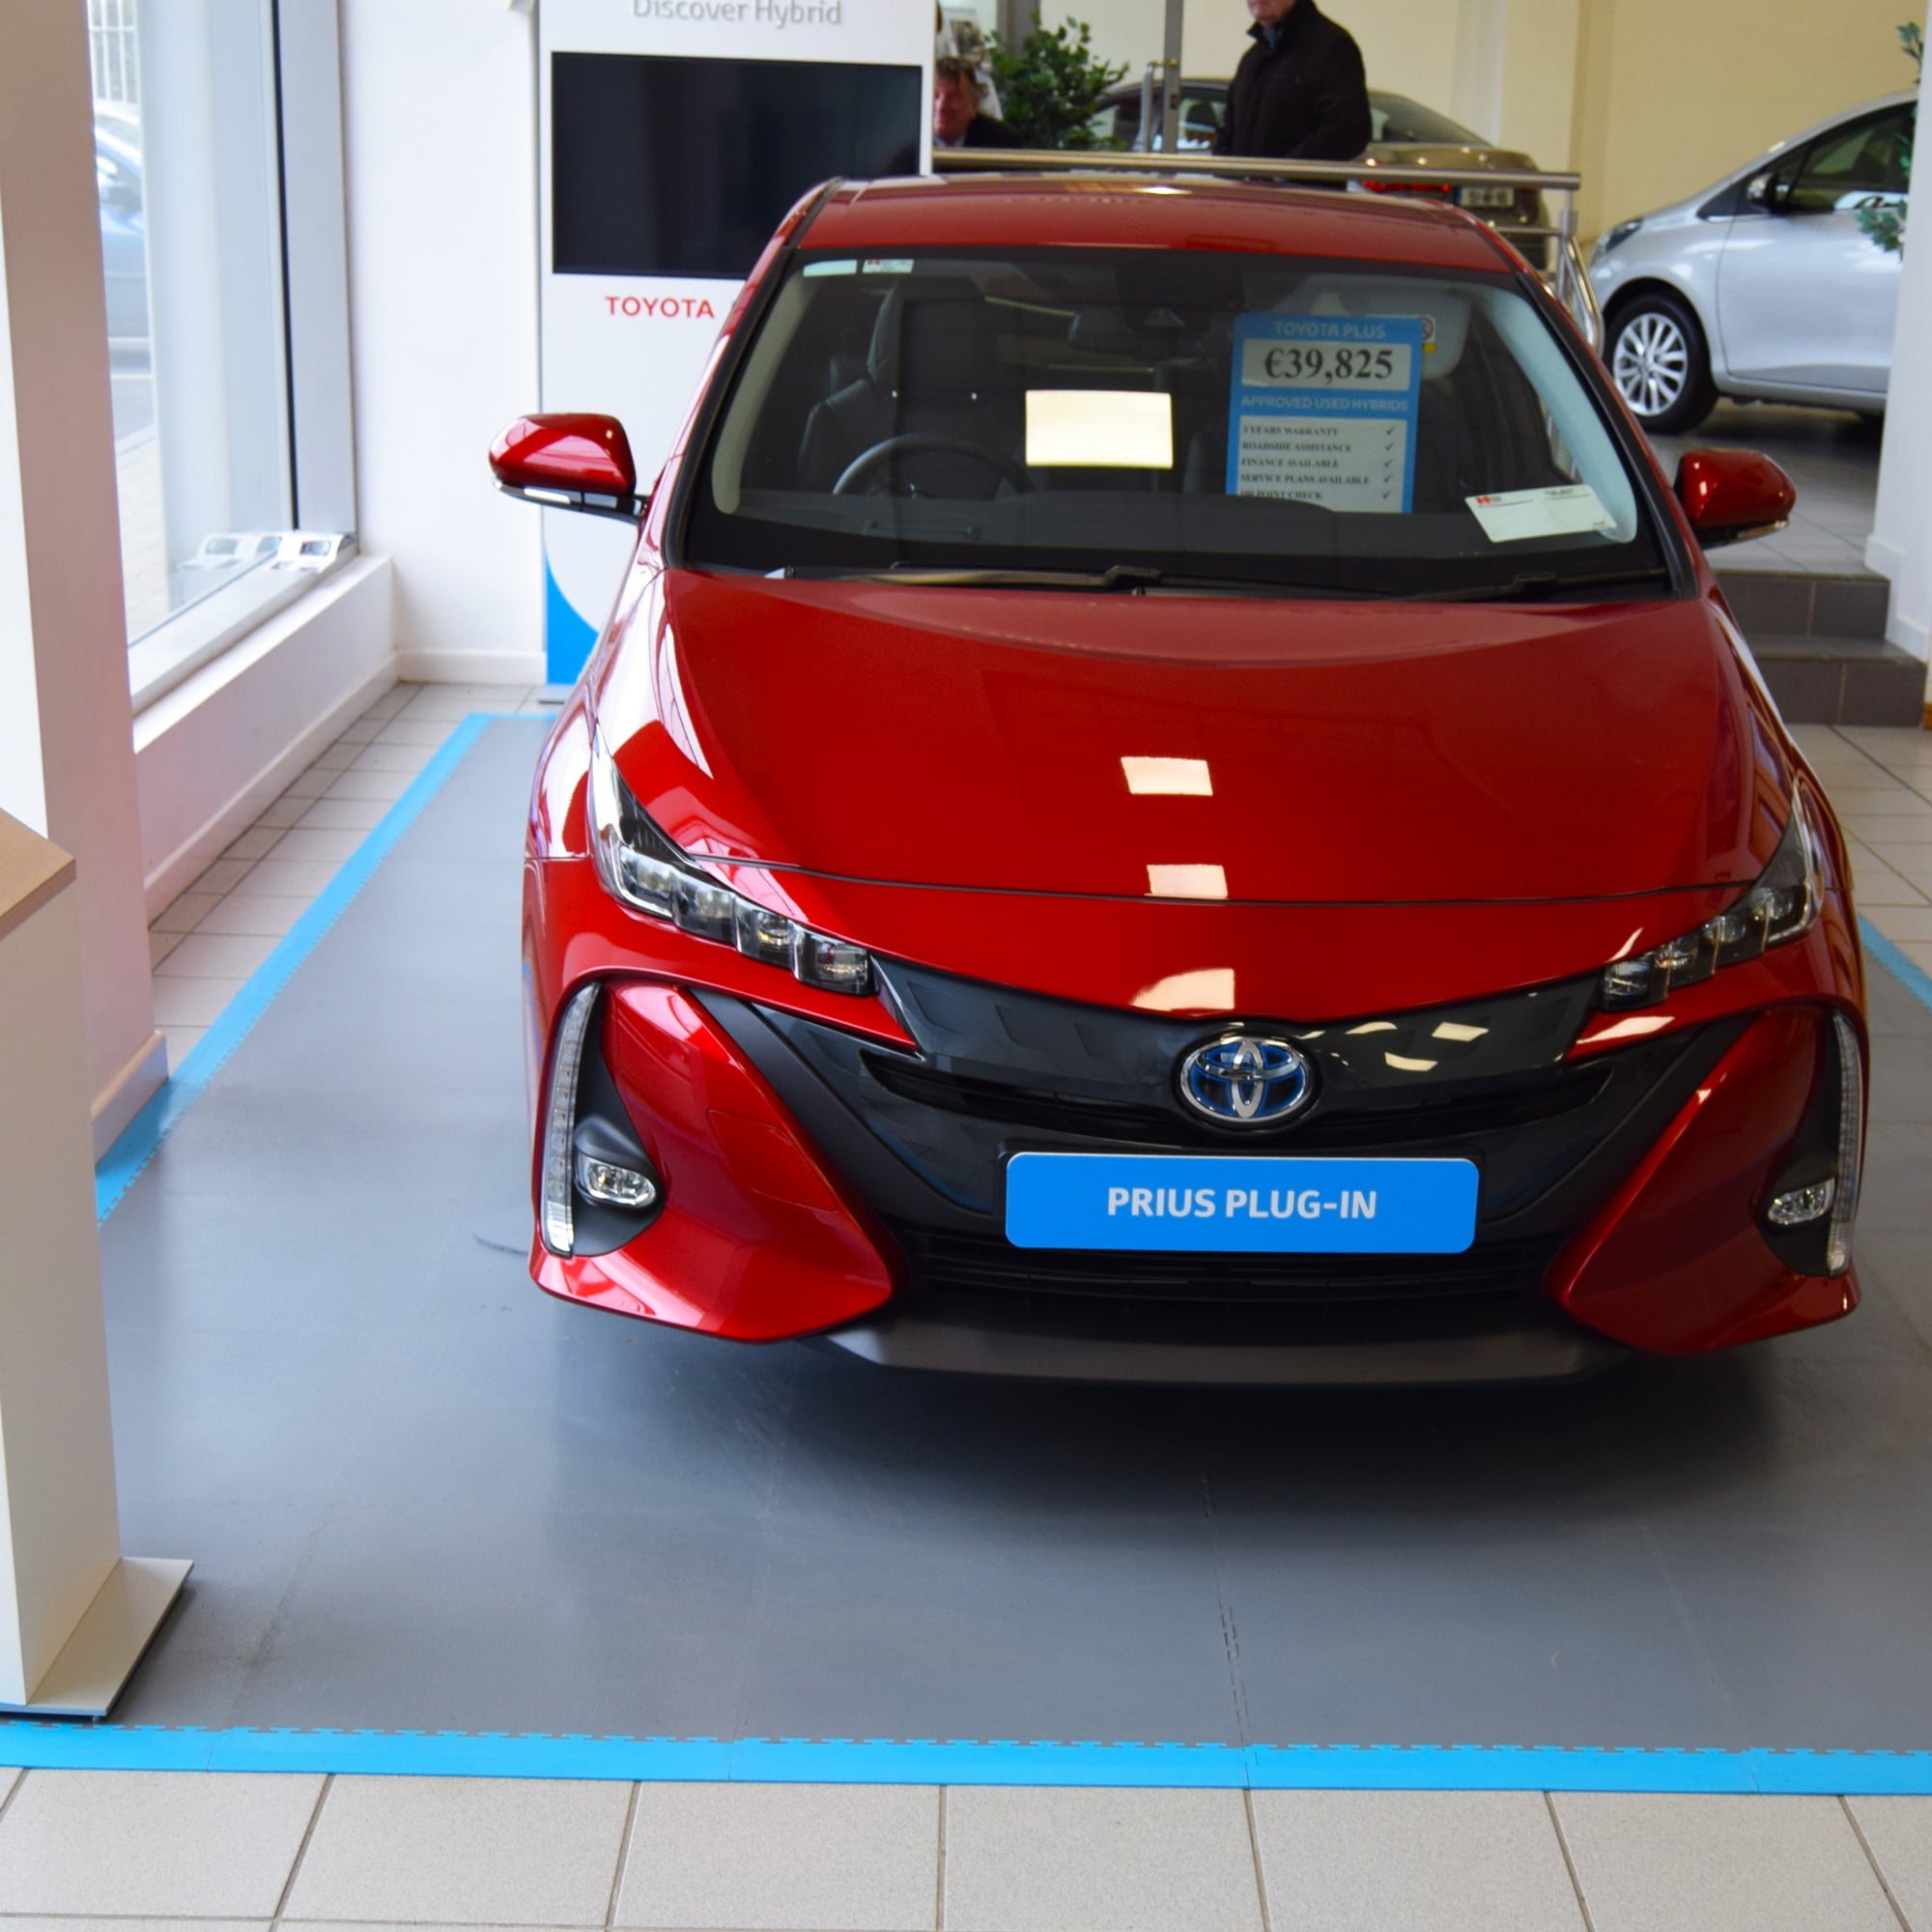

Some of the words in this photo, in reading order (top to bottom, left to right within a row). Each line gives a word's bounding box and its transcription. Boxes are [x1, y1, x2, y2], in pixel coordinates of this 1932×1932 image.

[633, 0, 749, 21] Discover
[754, 0, 842, 30] Hybrid
[605, 296, 715, 319] TOYOTA
[1274, 321, 1340, 336] TOYOTA
[1343, 325, 1386, 339] PLUS
[1264, 348, 1394, 384] €39,825
[1240, 395, 1313, 409] APPROVED
[1315, 398, 1350, 410] USED
[1352, 399, 1409, 412] HYBRIDS
[1250, 425, 1282, 434] YEARS
[1284, 426, 1338, 437] WARRANTY
[1242, 441, 1292, 451] ROADSIDE
[1294, 442, 1351, 452] ASSISTANCE
[1241, 458, 1284, 467] FINANCE
[1287, 459, 1339, 469] AVAILABLE
[1240, 473, 1281, 482] SERVICE
[1284, 474, 1315, 483] PLANS
[1318, 475, 1370, 485] AVAILABLE
[1288, 491, 1322, 500] CHECK
[1107, 1187, 1215, 1218] PRIUS
[1226, 1189, 1378, 1219] PLUG-IN
